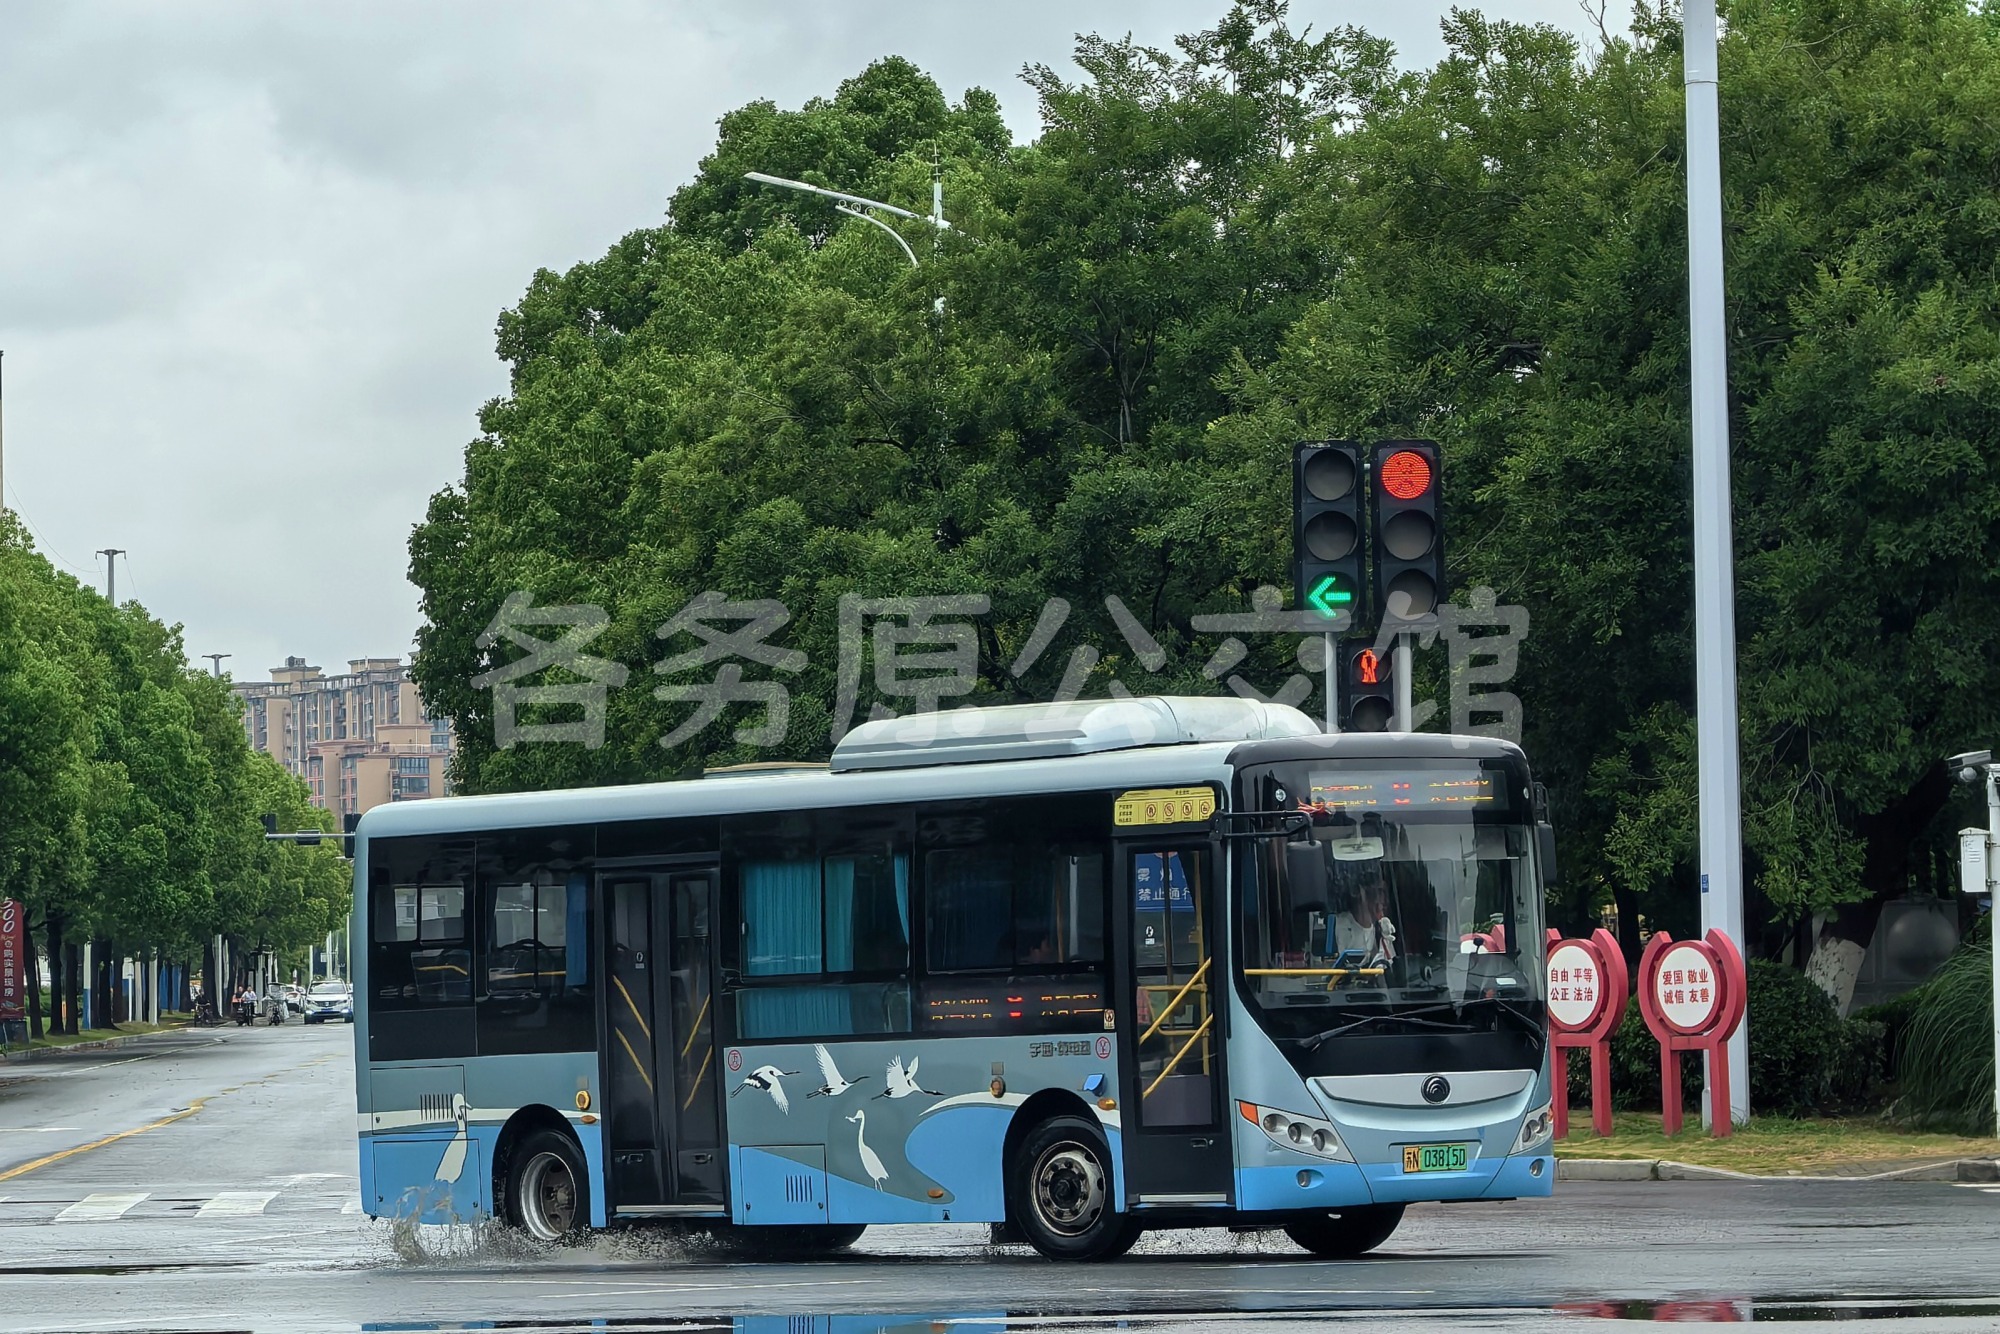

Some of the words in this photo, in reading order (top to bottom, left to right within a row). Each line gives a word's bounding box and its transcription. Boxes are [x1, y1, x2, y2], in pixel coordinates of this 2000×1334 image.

[1551, 967, 1569, 983] 自由
[1573, 967, 1593, 983] 平等
[1663, 970, 1683, 985] 爱国
[1687, 968, 1709, 984] 敬业
[1550, 987, 1570, 1002] 公正
[1573, 987, 1593, 1002] 法治
[1664, 990, 1685, 1005] 诚信
[1689, 988, 1710, 1004] 友善
